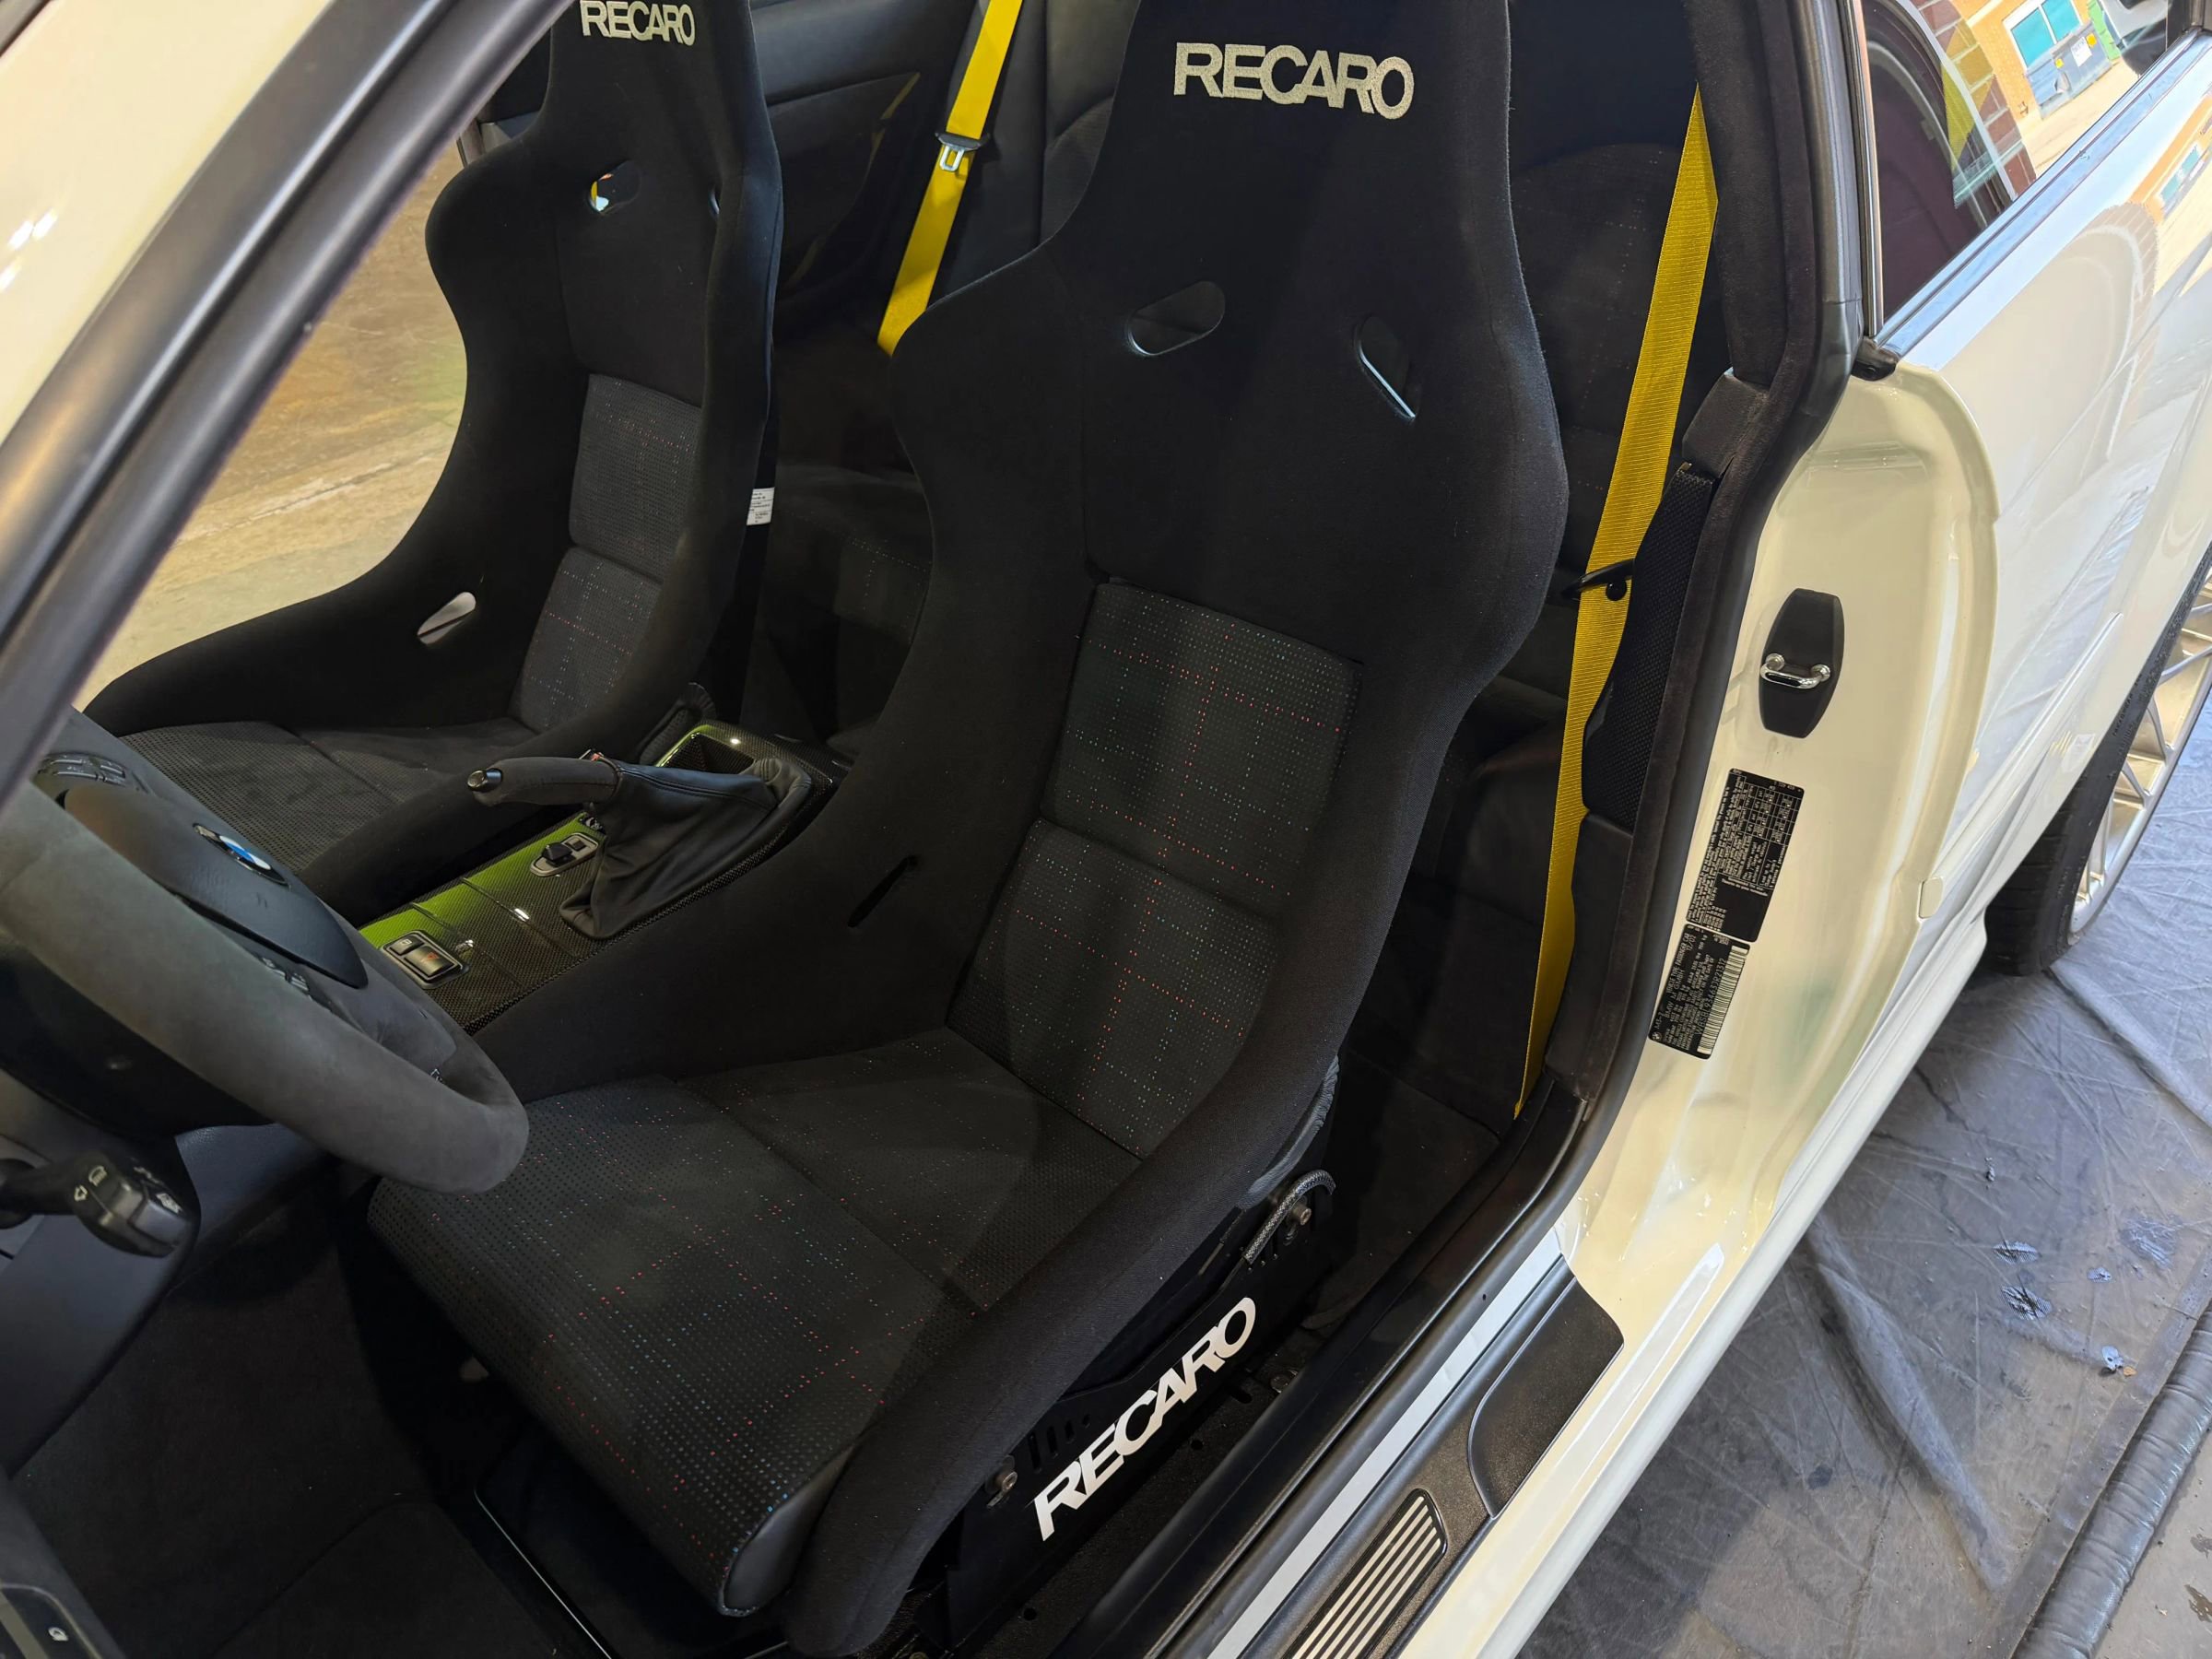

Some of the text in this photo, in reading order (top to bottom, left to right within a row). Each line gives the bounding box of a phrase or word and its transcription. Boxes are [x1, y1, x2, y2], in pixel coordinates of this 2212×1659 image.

[580, 0, 696, 46] RECARO
[1173, 41, 1415, 120] RECARO
[1664, 1000, 1674, 1018] BMW
[1033, 1297, 1256, 1541] RECARO
